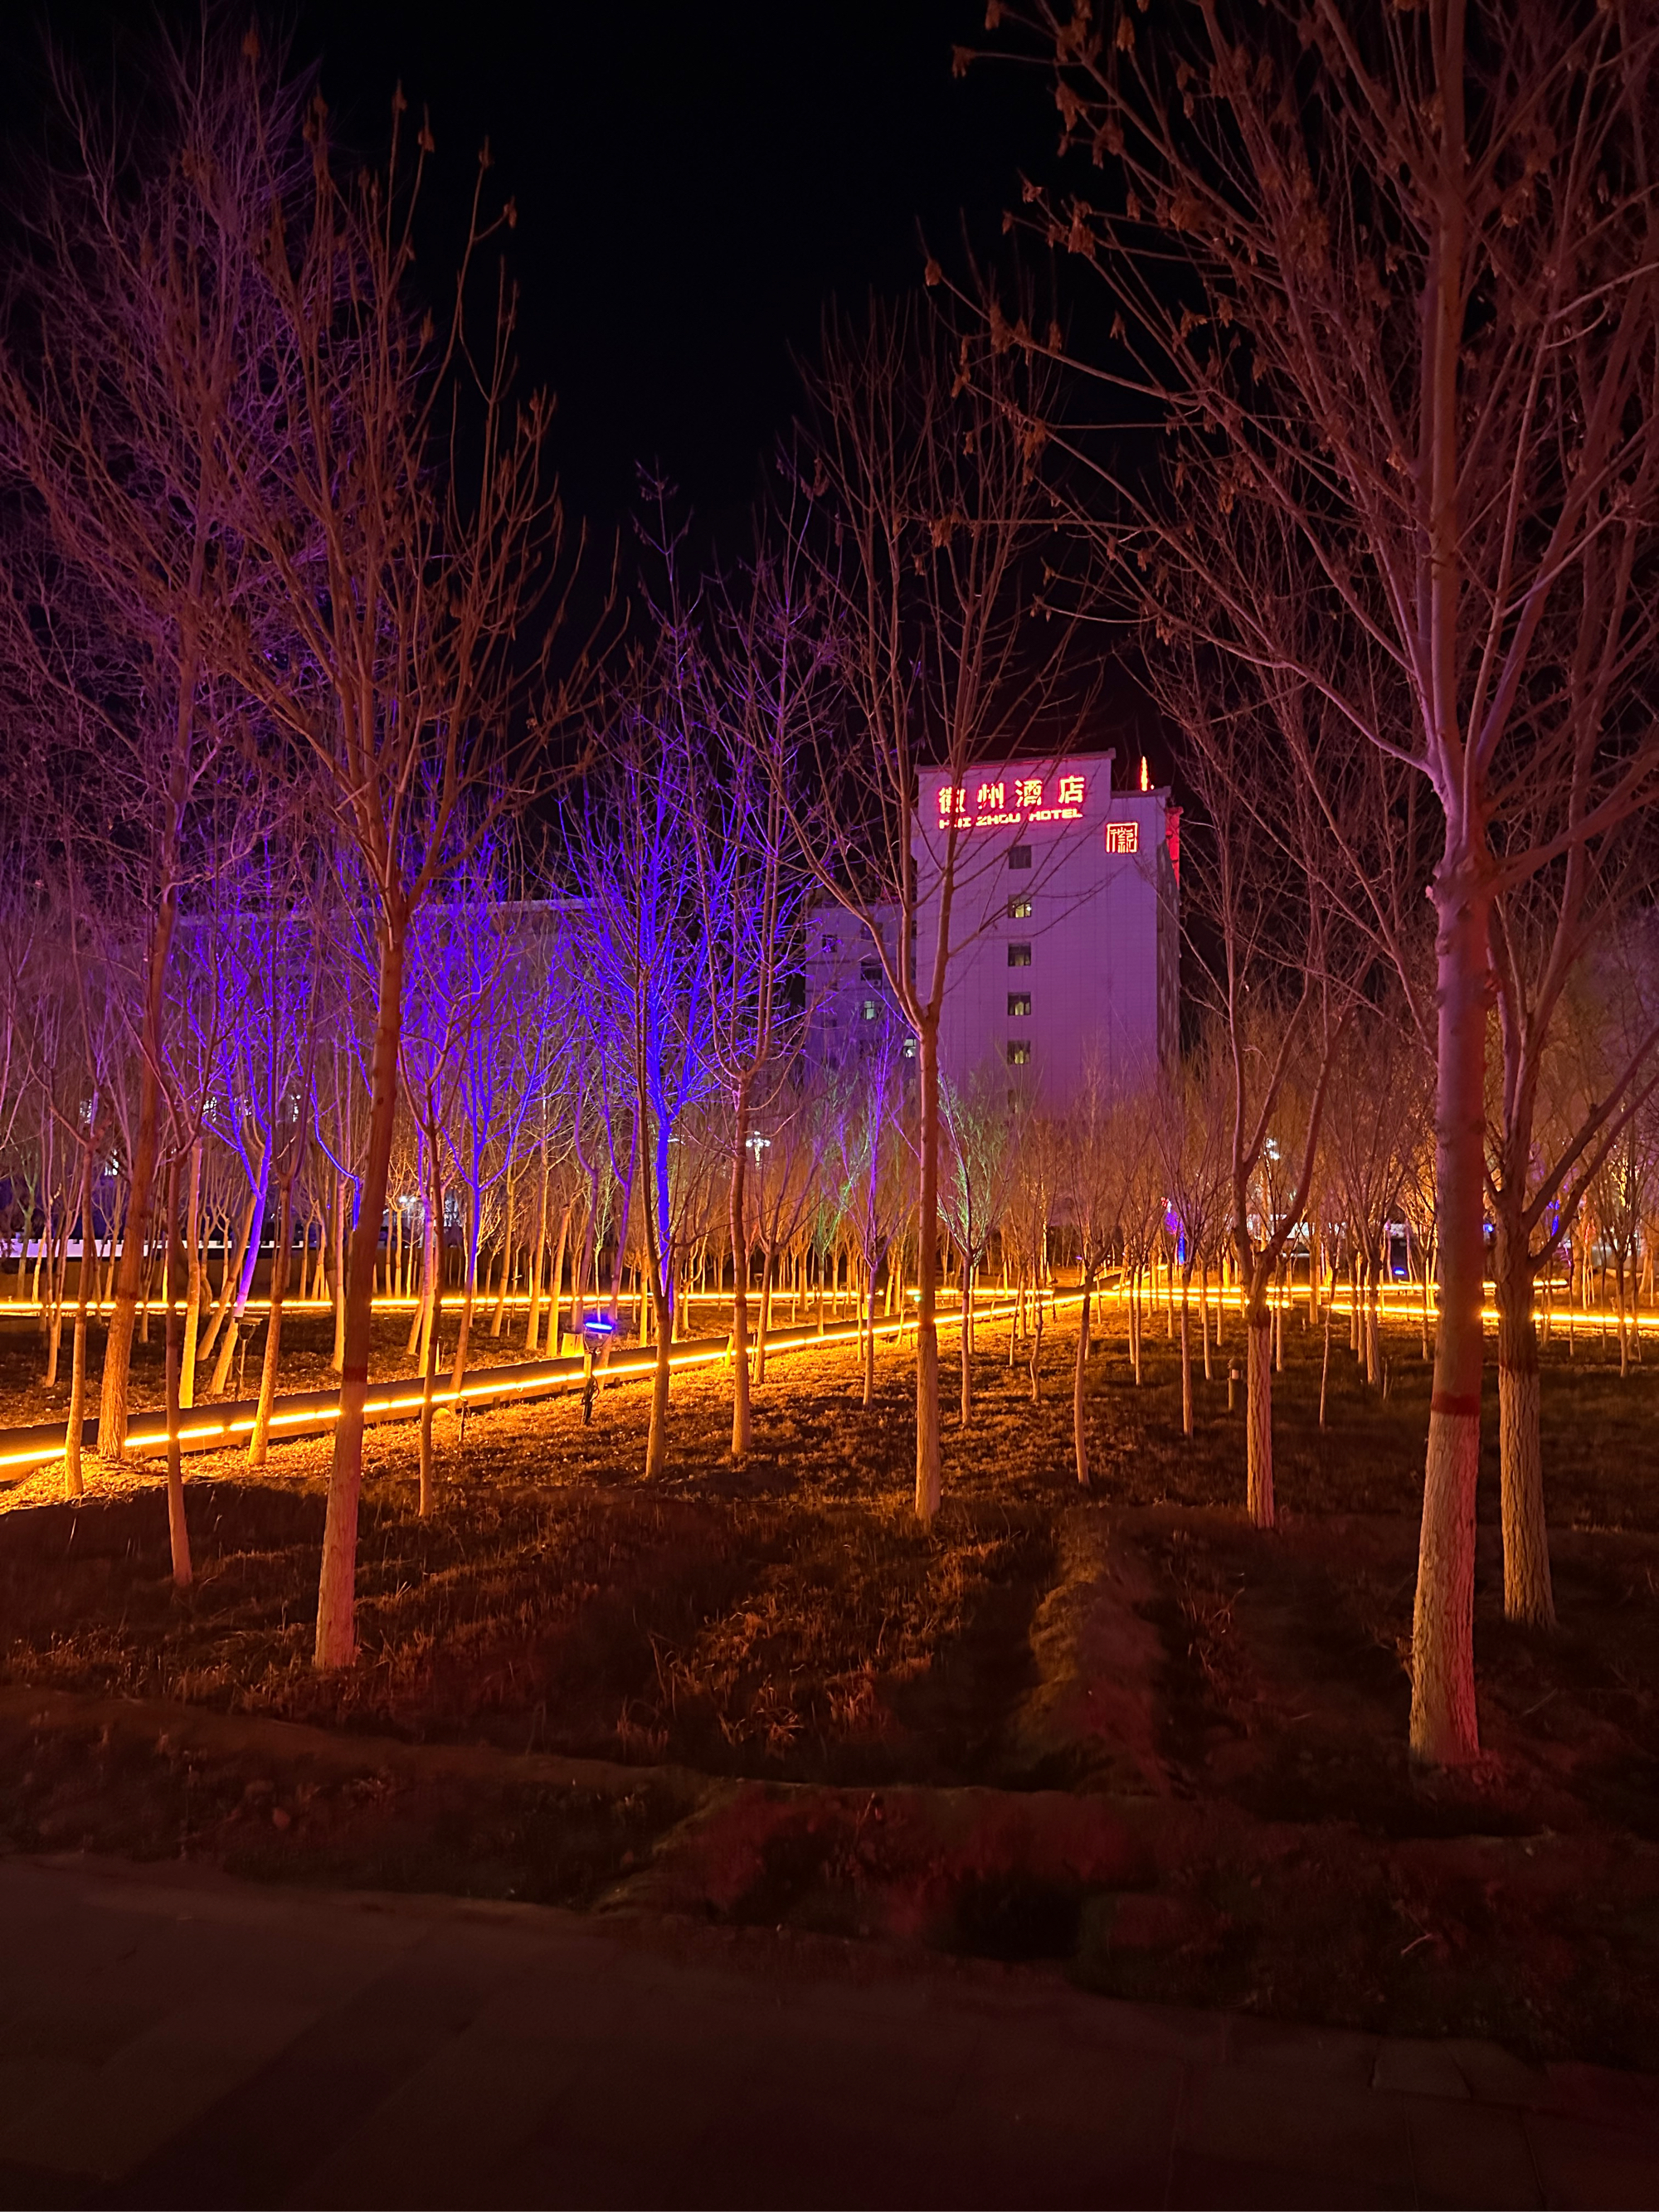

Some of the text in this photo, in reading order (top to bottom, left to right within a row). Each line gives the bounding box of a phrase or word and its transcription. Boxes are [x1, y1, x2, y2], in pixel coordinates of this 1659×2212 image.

[938, 775, 1085, 814] 徽州酒店
[975, 813, 1021, 827] ZHOU
[1029, 808, 1083, 821] HOTEL
